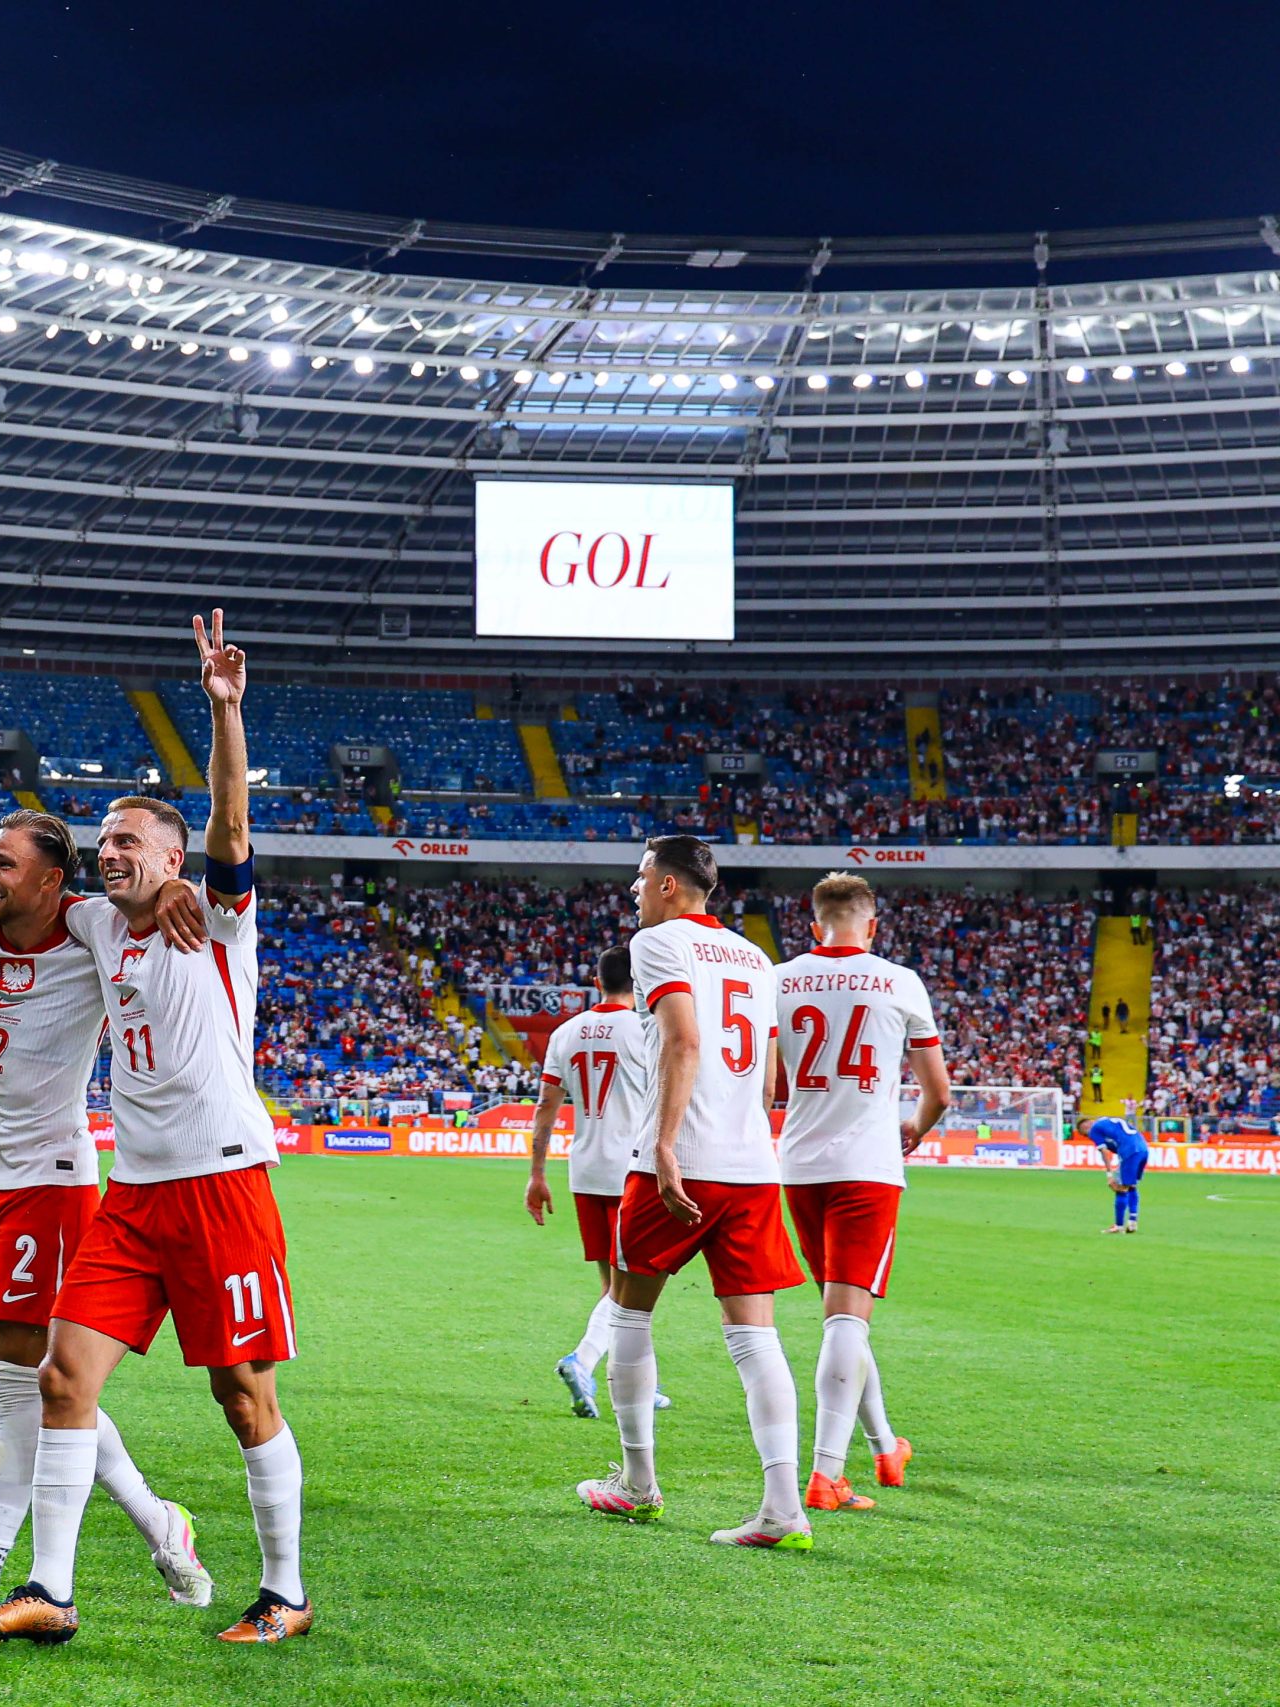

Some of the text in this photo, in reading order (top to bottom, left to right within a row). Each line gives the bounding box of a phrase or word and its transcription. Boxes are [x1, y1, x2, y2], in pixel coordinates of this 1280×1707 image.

[539, 530, 671, 589] GOL
[421, 843, 468, 855] ORLEN
[875, 850, 925, 862] ORLEN
[692, 942, 766, 973] BEDNAREK
[781, 973, 895, 995] SKRZYPCZAK
[122, 1024, 156, 1072] 11
[580, 1025, 614, 1040] SLISZ
[721, 978, 756, 1077] 5
[791, 1004, 880, 1093] 24
[570, 1051, 619, 1119] 17
[409, 1131, 528, 1154] OFICJALNA
[12, 1234, 37, 1283] 2
[225, 1271, 263, 1323] 11
